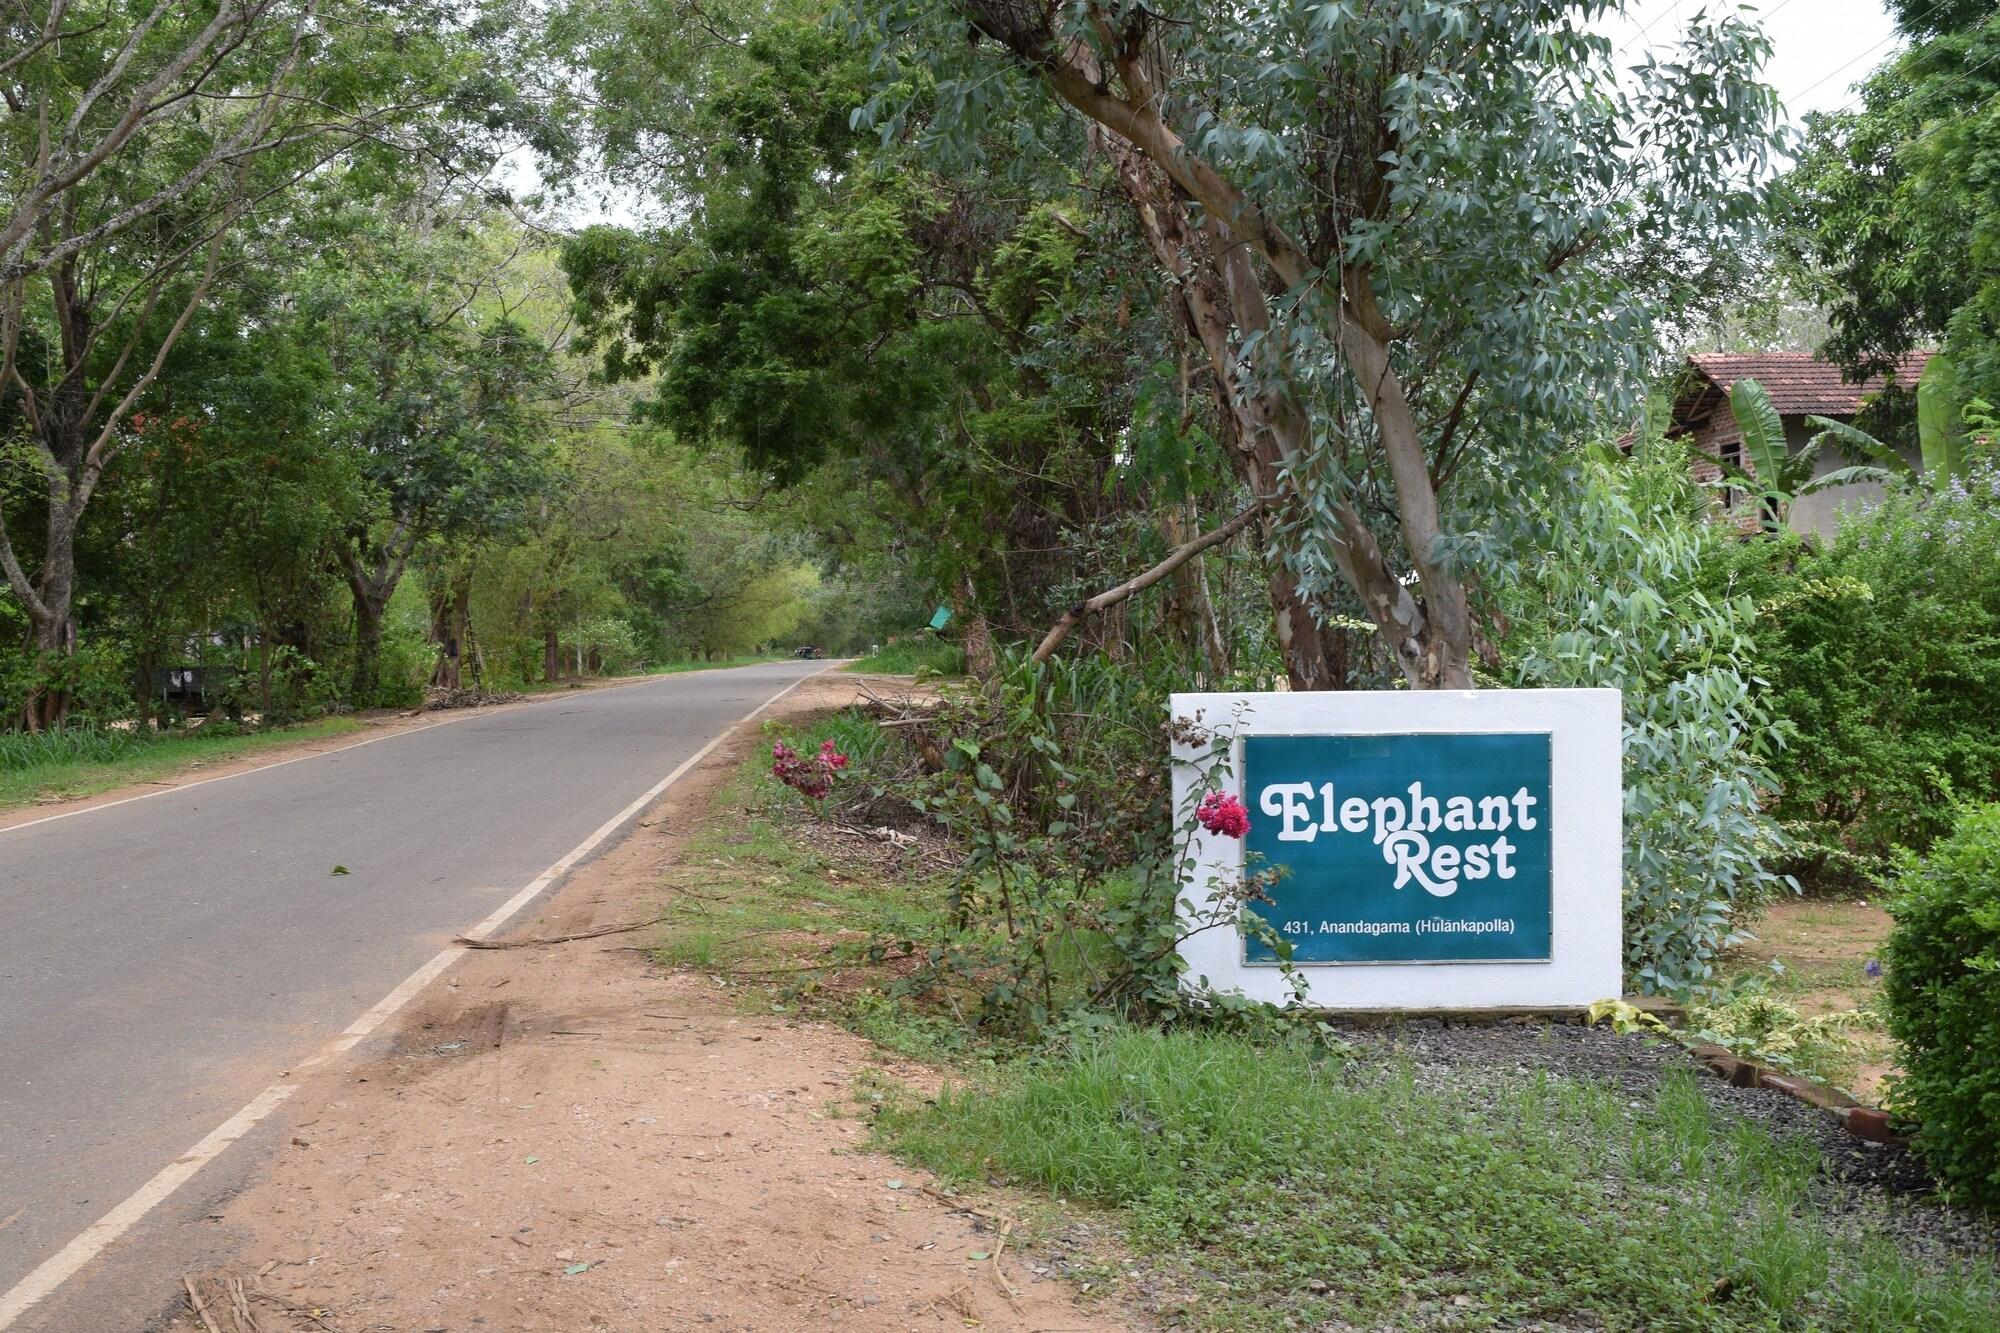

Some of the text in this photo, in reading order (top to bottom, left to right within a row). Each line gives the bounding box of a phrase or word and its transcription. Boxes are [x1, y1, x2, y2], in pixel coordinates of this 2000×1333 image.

[1259, 781, 1537, 844] Elephant
[1382, 830, 1517, 897] Rest
[1283, 920, 1315, 936] 431,
[1319, 919, 1410, 937] Anandagama
